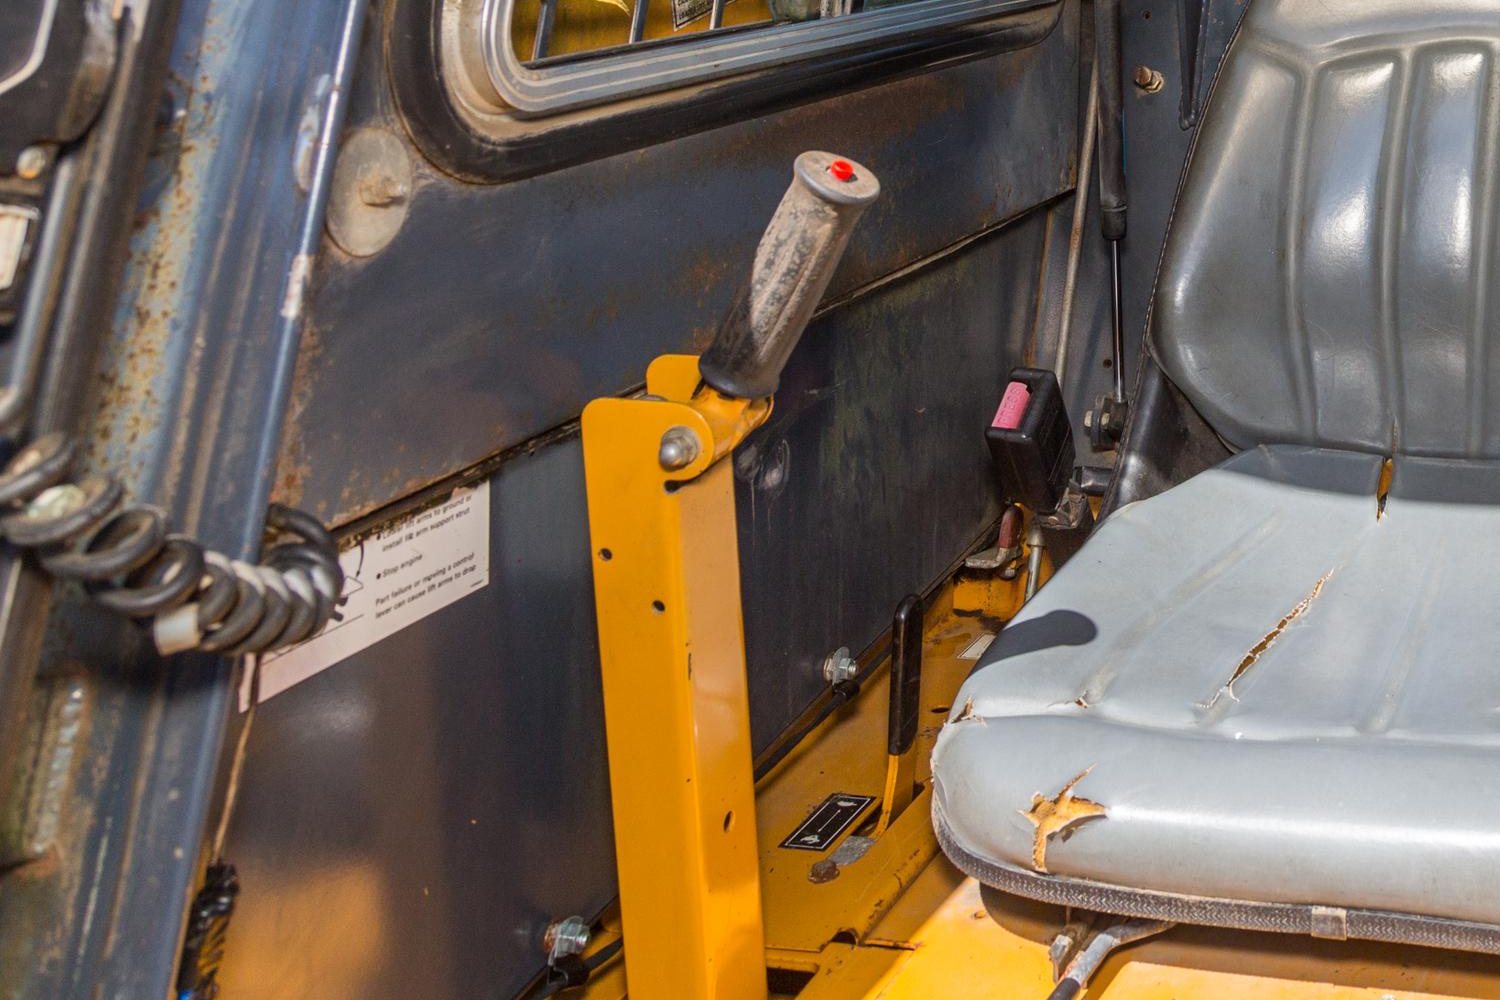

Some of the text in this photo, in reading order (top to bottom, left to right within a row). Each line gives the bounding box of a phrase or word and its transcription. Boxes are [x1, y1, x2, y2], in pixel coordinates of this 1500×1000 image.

[442, 497, 464, 514] ground
[430, 514, 454, 530] support
[455, 507, 470, 519] strut
[382, 554, 423, 578] Stop engine
[376, 595, 390, 606] Part
[391, 584, 412, 598] failure
[422, 567, 446, 582] moving
[453, 551, 475, 569] control
[376, 606, 393, 619] lever
[393, 599, 405, 610] can
[407, 590, 426, 603] cause
[427, 583, 436, 593] lift
[437, 576, 453, 588] arms
[462, 564, 477, 576] drop
